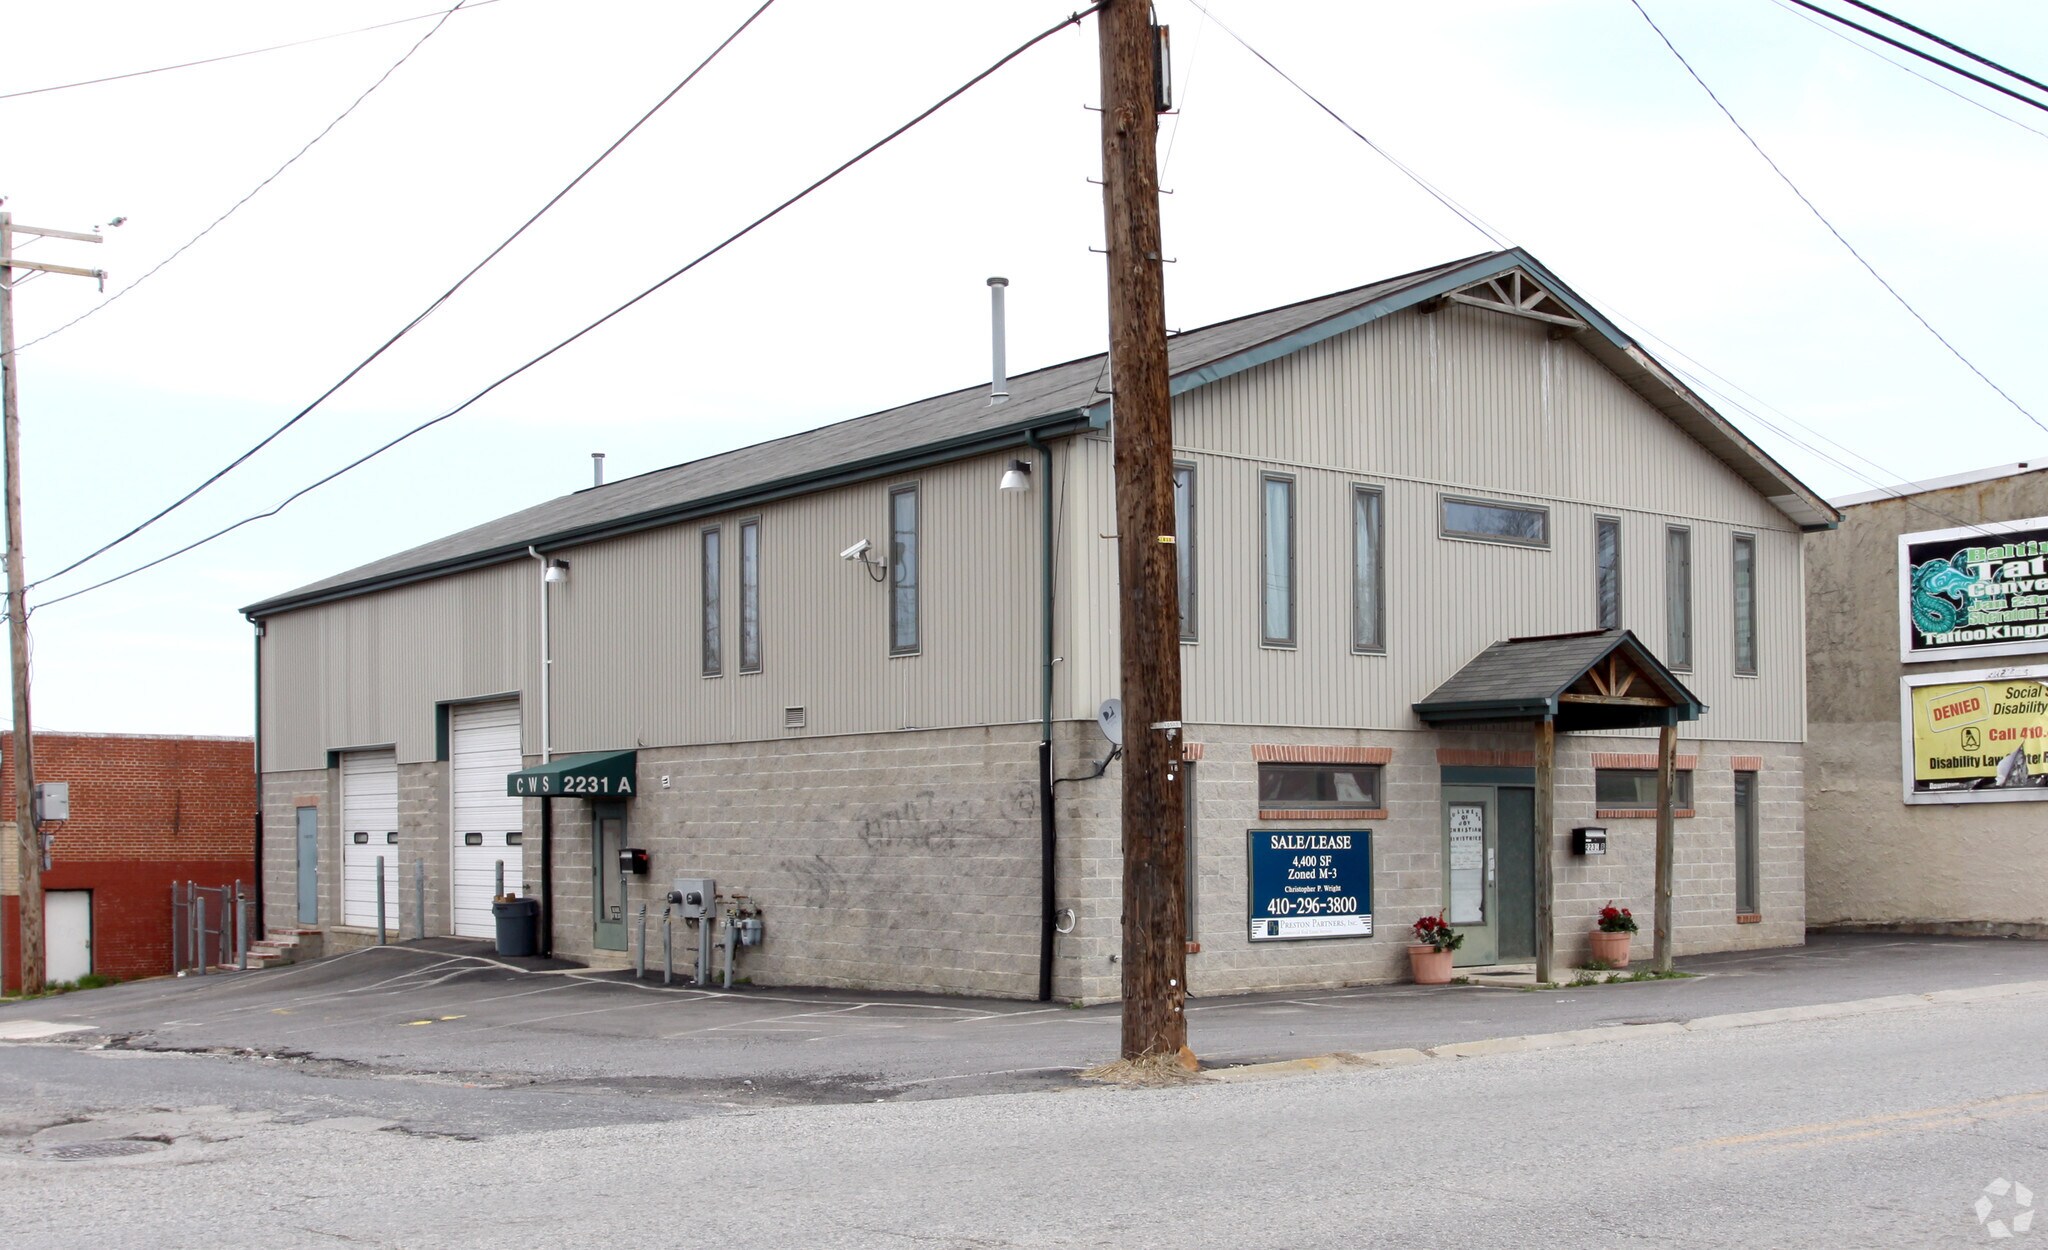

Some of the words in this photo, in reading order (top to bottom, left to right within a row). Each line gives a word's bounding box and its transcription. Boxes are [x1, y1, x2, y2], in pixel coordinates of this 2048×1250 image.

[1966, 556, 2048, 580] Tat
[1967, 598, 2008, 612] Jan
[1967, 607, 2038, 626] Sheraton
[2005, 686, 2042, 700] Social
[1933, 697, 1981, 721] DENIED
[1993, 701, 2048, 715] Disability
[1989, 728, 2016, 741] Call
[2020, 726, 2048, 739] 410.
[1929, 755, 1980, 769] Disability
[563, 775, 609, 793] 2231
[617, 776, 632, 793] A
[1271, 835, 1352, 849] SALE/LEASE
[1292, 855, 1317, 868] 4,400
[1319, 855, 1332, 867] SF
[1288, 868, 1316, 880] Zoned
[1319, 868, 1337, 879] M-3
[1284, 885, 1316, 894] Christopher
[1324, 885, 1341, 893] Wright
[1267, 896, 1357, 914] 410-296-3800
